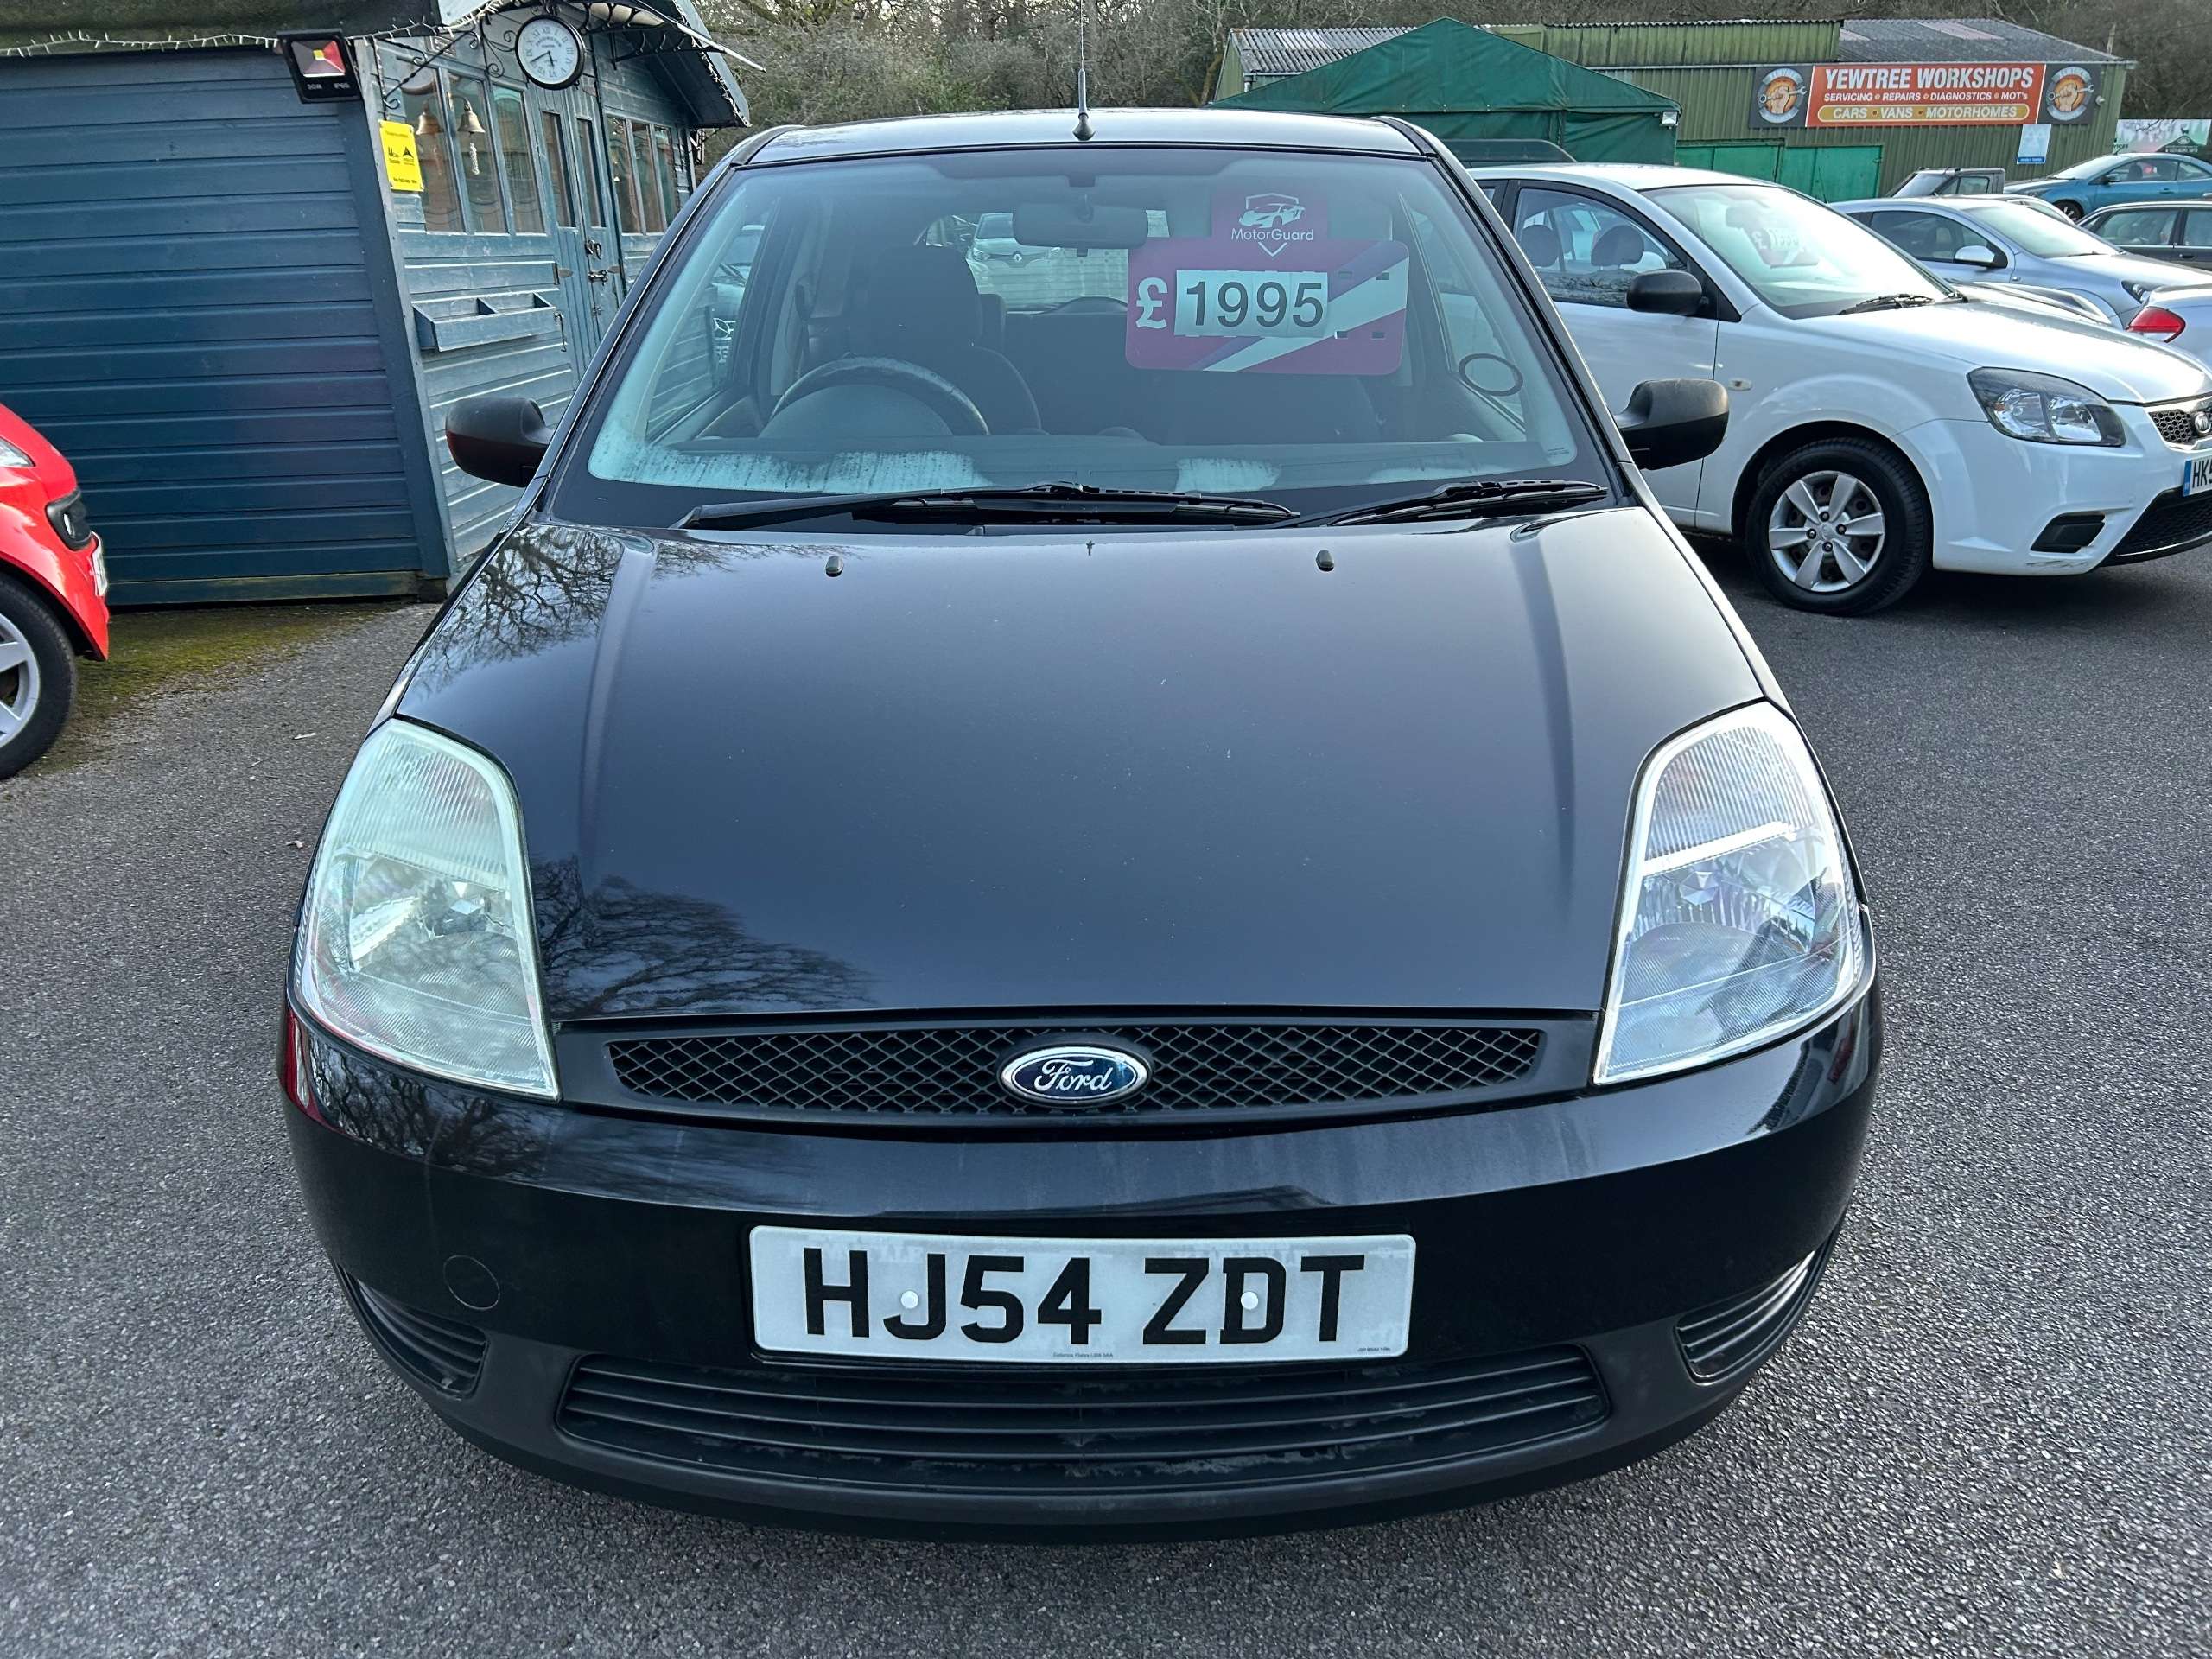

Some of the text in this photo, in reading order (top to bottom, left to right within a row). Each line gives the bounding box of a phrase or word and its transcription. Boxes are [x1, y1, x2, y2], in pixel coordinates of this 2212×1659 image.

[1825, 67, 1911, 89] YEWTREE
[1917, 67, 2034, 88] WORKSHOPS
[1824, 92, 2028, 102] SERVICING REPAIRS DIAGNOSTICS MOT's
[1833, 106, 2017, 119] CARS VANS MOTORHOMES
[1230, 227, 1314, 242] MotorGuard
[1033, 1058, 1114, 1091] Ford
[802, 1246, 1365, 1345] HJ54 ZDT
